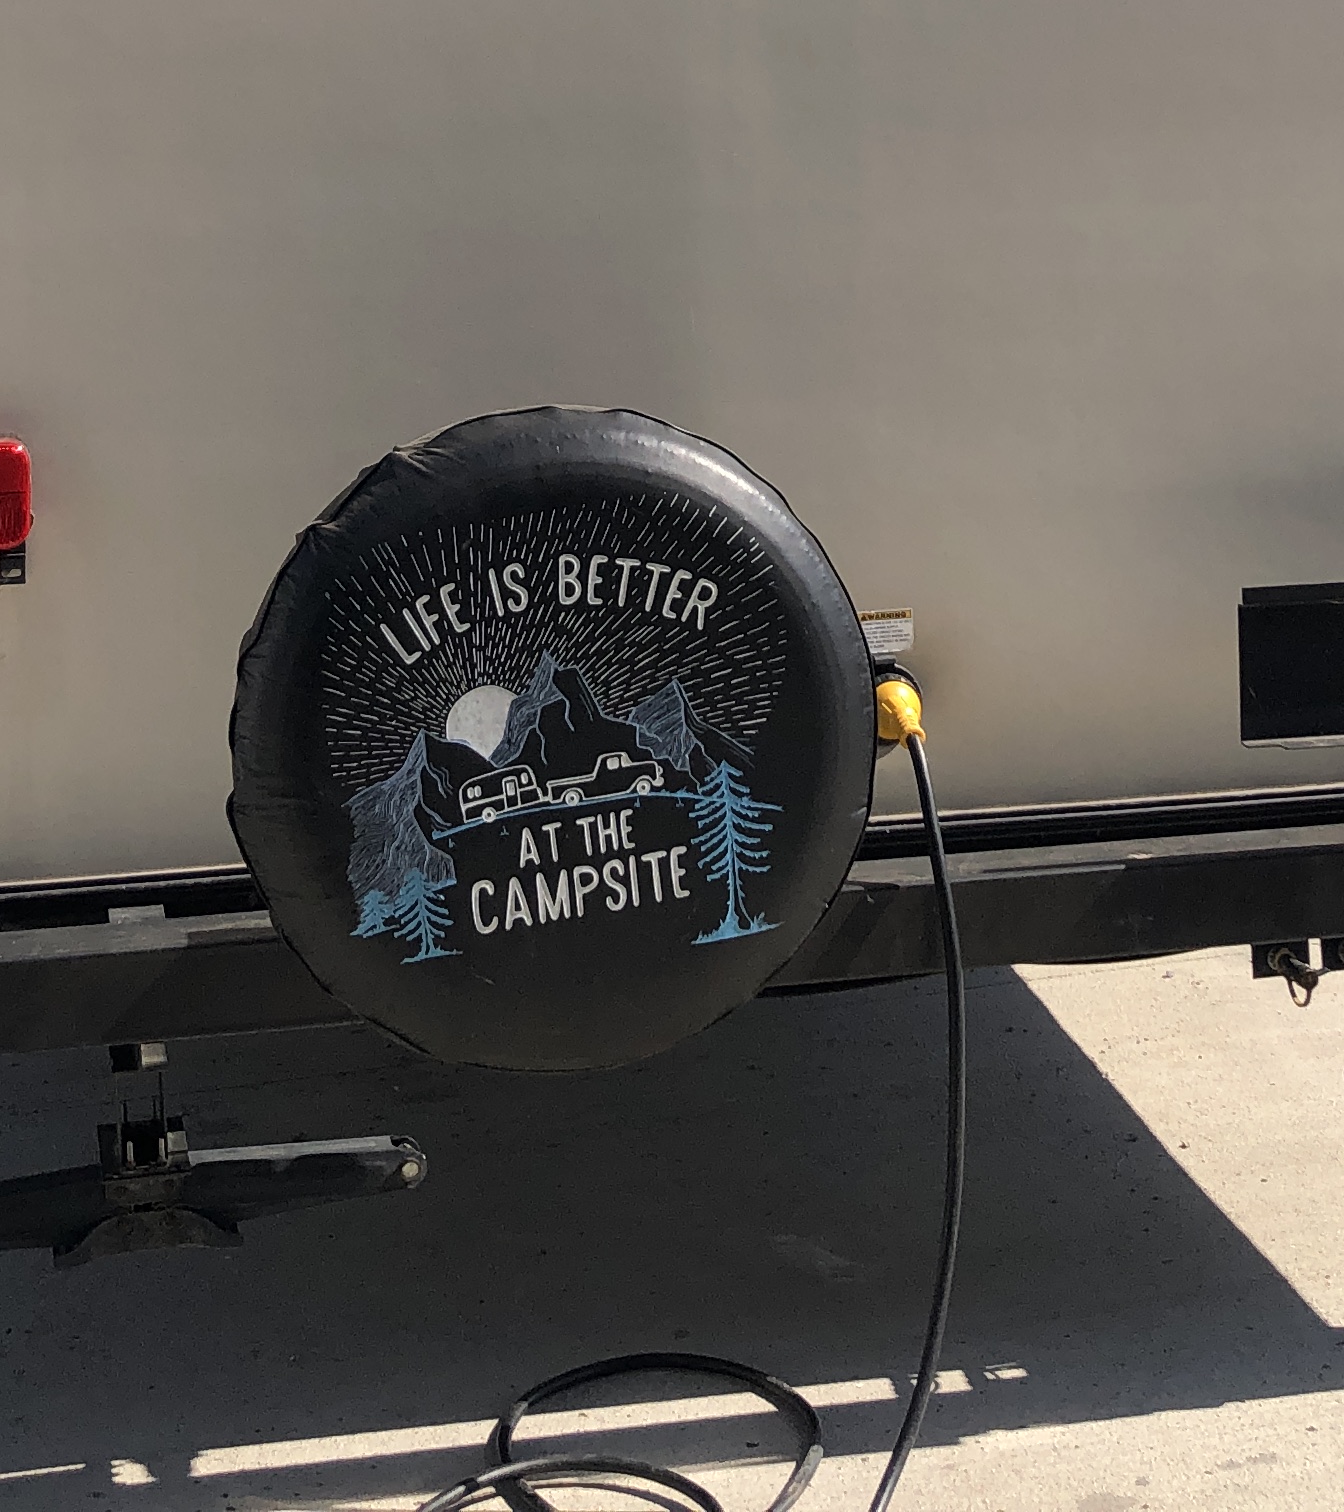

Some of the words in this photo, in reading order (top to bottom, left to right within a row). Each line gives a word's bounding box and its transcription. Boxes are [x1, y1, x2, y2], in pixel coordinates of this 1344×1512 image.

[379, 582, 471, 666] LIFE
[488, 562, 529, 615] IS
[558, 554, 719, 629] BETTER
[519, 823, 559, 868] AT
[575, 809, 635, 858] THE
[471, 846, 691, 934] CAMPSITE
